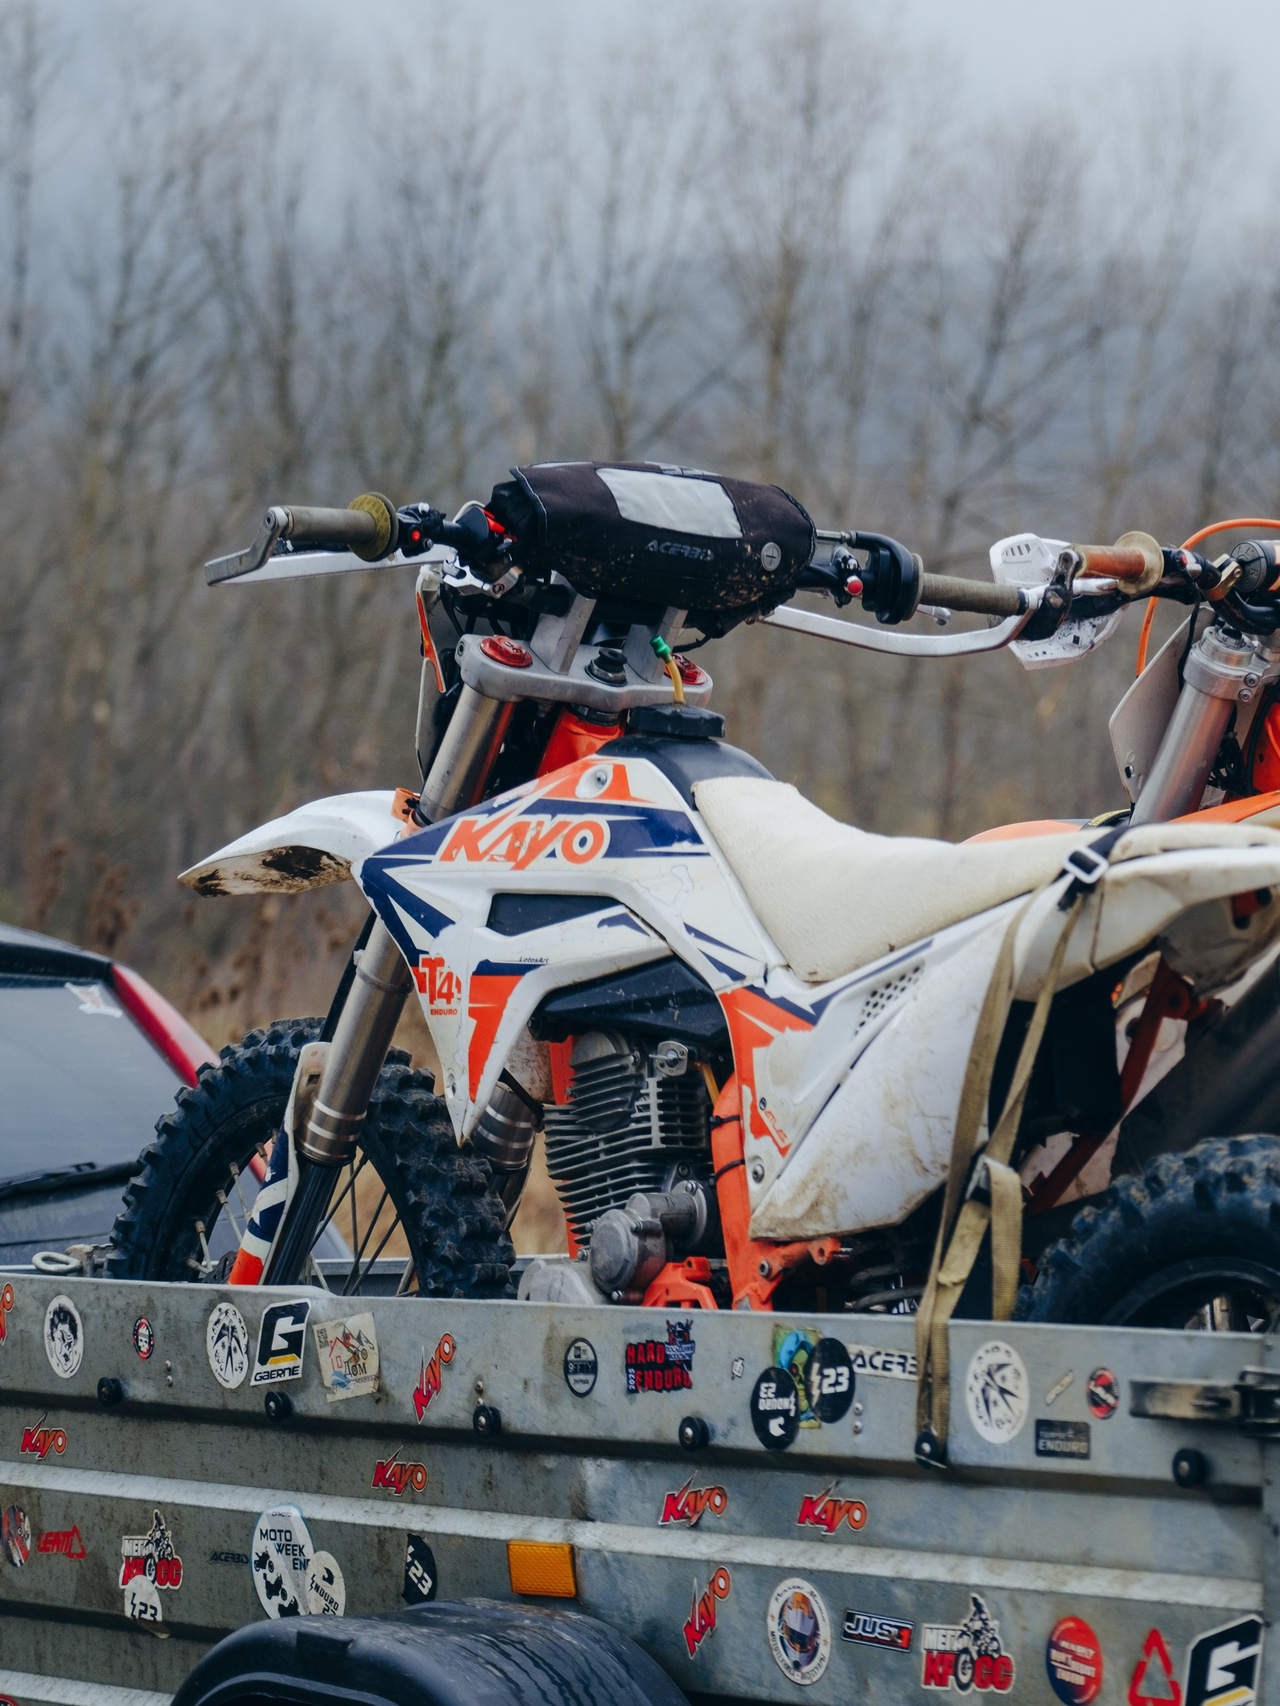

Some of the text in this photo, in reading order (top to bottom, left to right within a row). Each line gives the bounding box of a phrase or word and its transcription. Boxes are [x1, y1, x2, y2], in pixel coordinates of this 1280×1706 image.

[439, 805, 605, 871] KAYO
[430, 1008, 458, 1016] ENDURO
[626, 1342, 665, 1364] HARD
[254, 1365, 300, 1382] GAERNE
[414, 1333, 454, 1422] KAYO
[628, 1368, 636, 1390] 2025
[635, 1367, 692, 1390] ENDURO
[20, 1413, 67, 1459] KAYO
[1038, 1439, 1088, 1453] ENDURO
[373, 1447, 427, 1496] KAYO
[659, 1472, 728, 1527] KAYO
[797, 1480, 867, 1535] KAYO
[259, 1528, 292, 1542] MOTO
[274, 1543, 306, 1557] WEEK
[683, 1566, 731, 1660] KAYO
